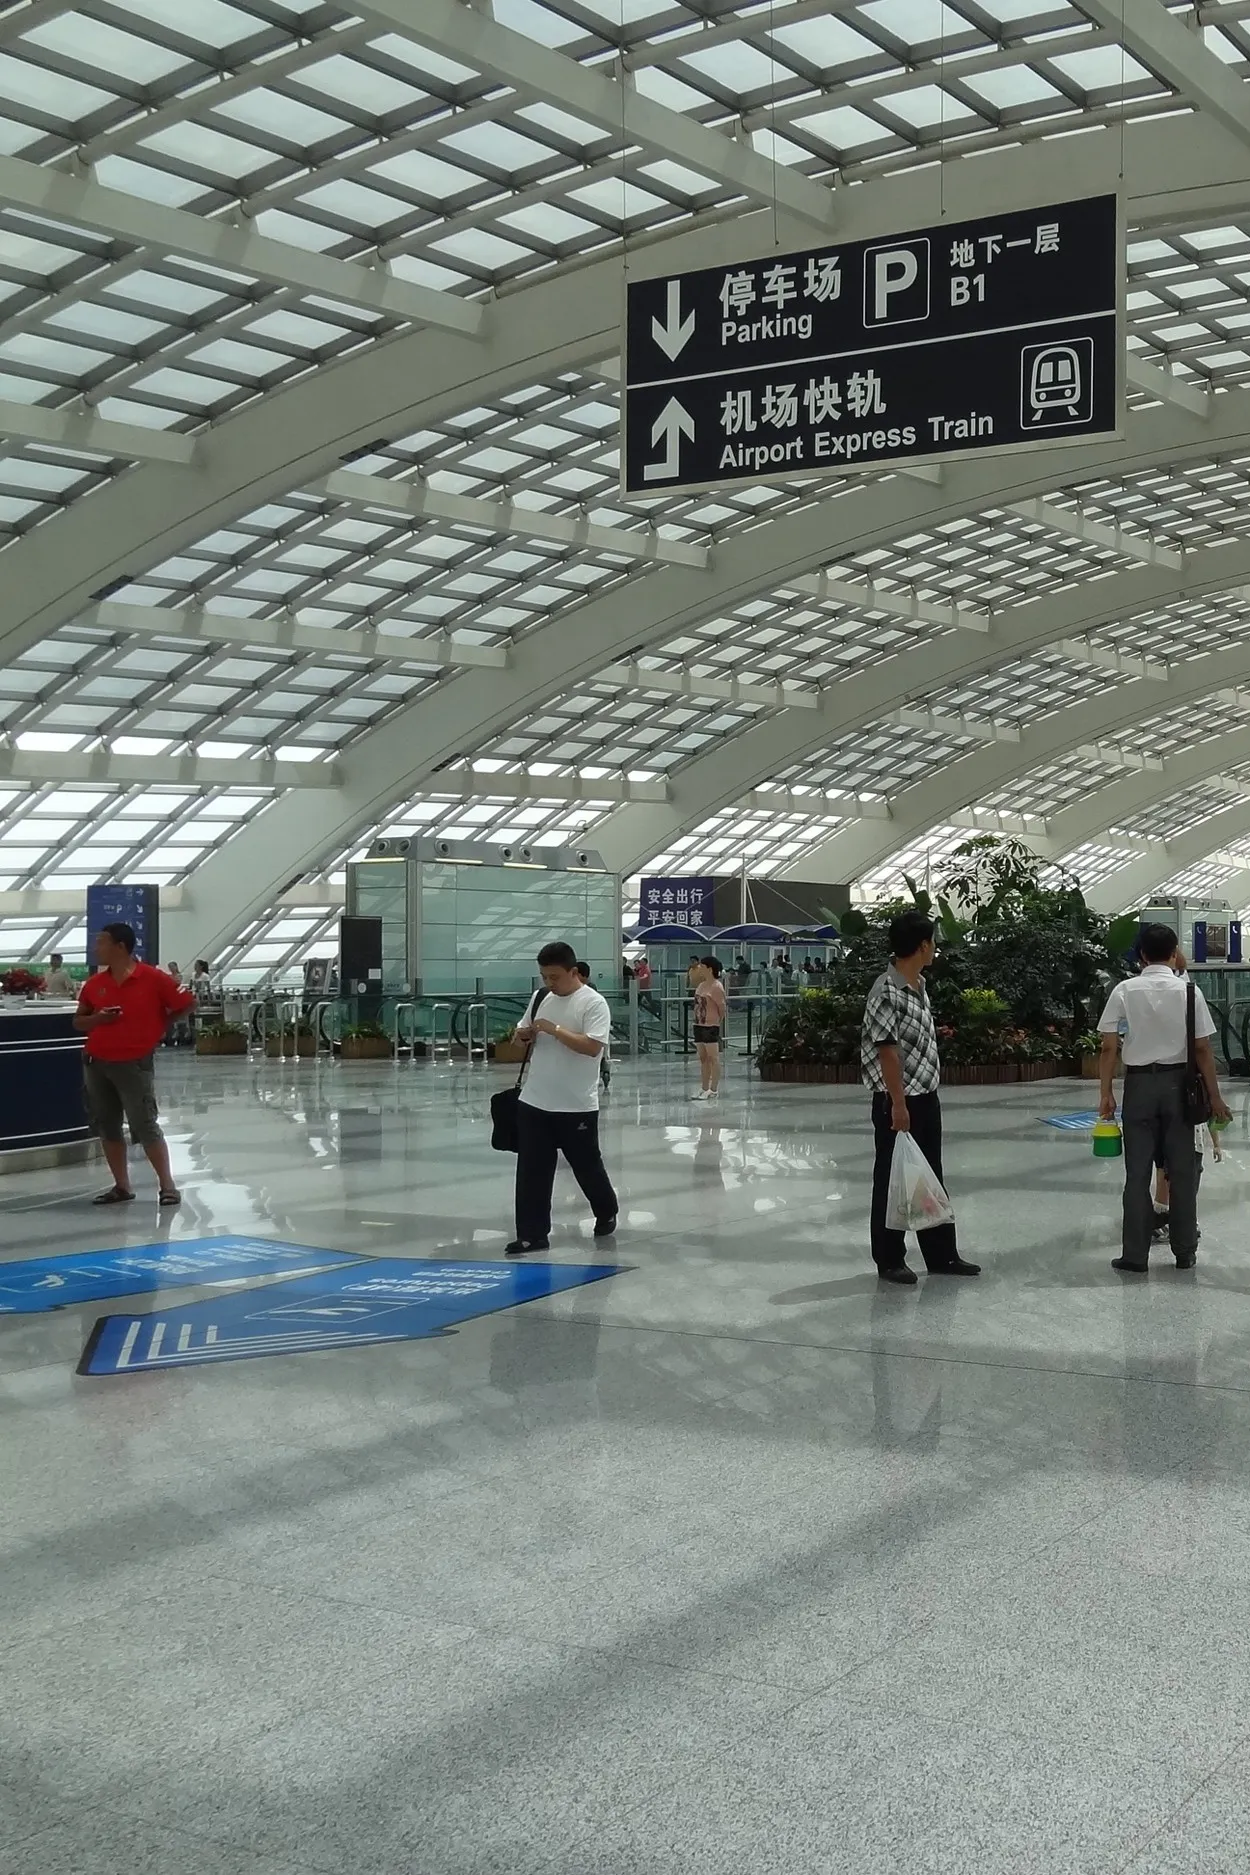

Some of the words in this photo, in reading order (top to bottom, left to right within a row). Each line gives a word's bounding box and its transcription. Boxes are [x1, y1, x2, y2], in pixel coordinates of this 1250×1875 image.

[950, 223, 1061, 269] 地下一层
[719, 256, 842, 318] 停车场
[874, 249, 918, 319] P
[950, 274, 986, 307] B1
[721, 312, 814, 346] Parking
[720, 369, 887, 436] 机场快轨
[719, 436, 804, 471] Airport
[814, 424, 917, 461] Express
[928, 412, 994, 442] Train
[647, 888, 704, 904] 安全出行
[647, 909, 703, 926] 平安回家
